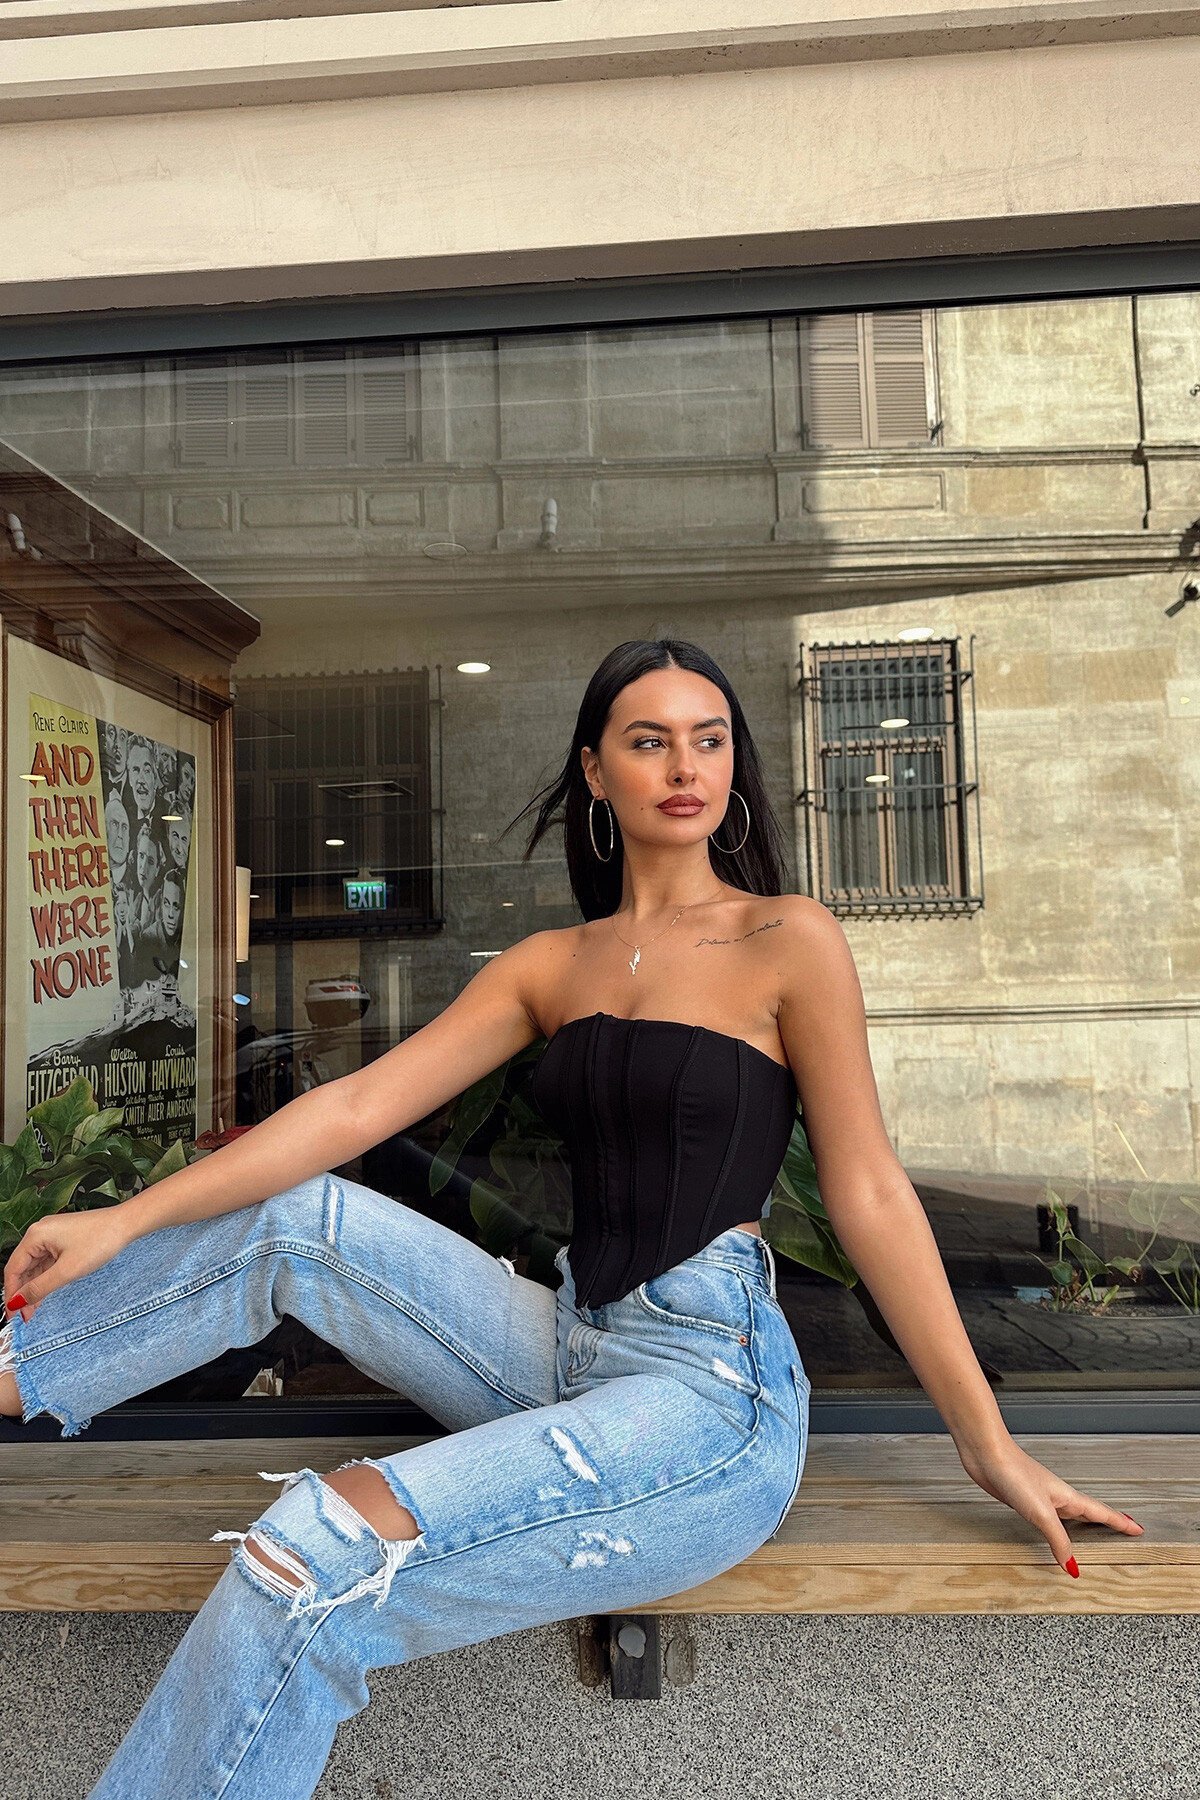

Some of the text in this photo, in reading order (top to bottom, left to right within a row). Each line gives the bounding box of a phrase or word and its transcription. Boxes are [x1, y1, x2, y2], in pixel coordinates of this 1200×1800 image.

[33, 712, 89, 735] RENE CLAIR'S
[29, 741, 95, 788] AND
[28, 794, 101, 842] THEN
[28, 842, 111, 898] THERE
[347, 885, 383, 908] EXIT
[30, 895, 112, 950] WERE
[30, 945, 114, 1005] NONE
[53, 1049, 81, 1066] Barry
[110, 1047, 139, 1062] Walter
[165, 1043, 186, 1057] Louis
[105, 1060, 146, 1098] HUSTON
[152, 1056, 197, 1092] HAYWARD
[124, 1105, 145, 1127] SMITH
[166, 1097, 196, 1119] ANDERSON
